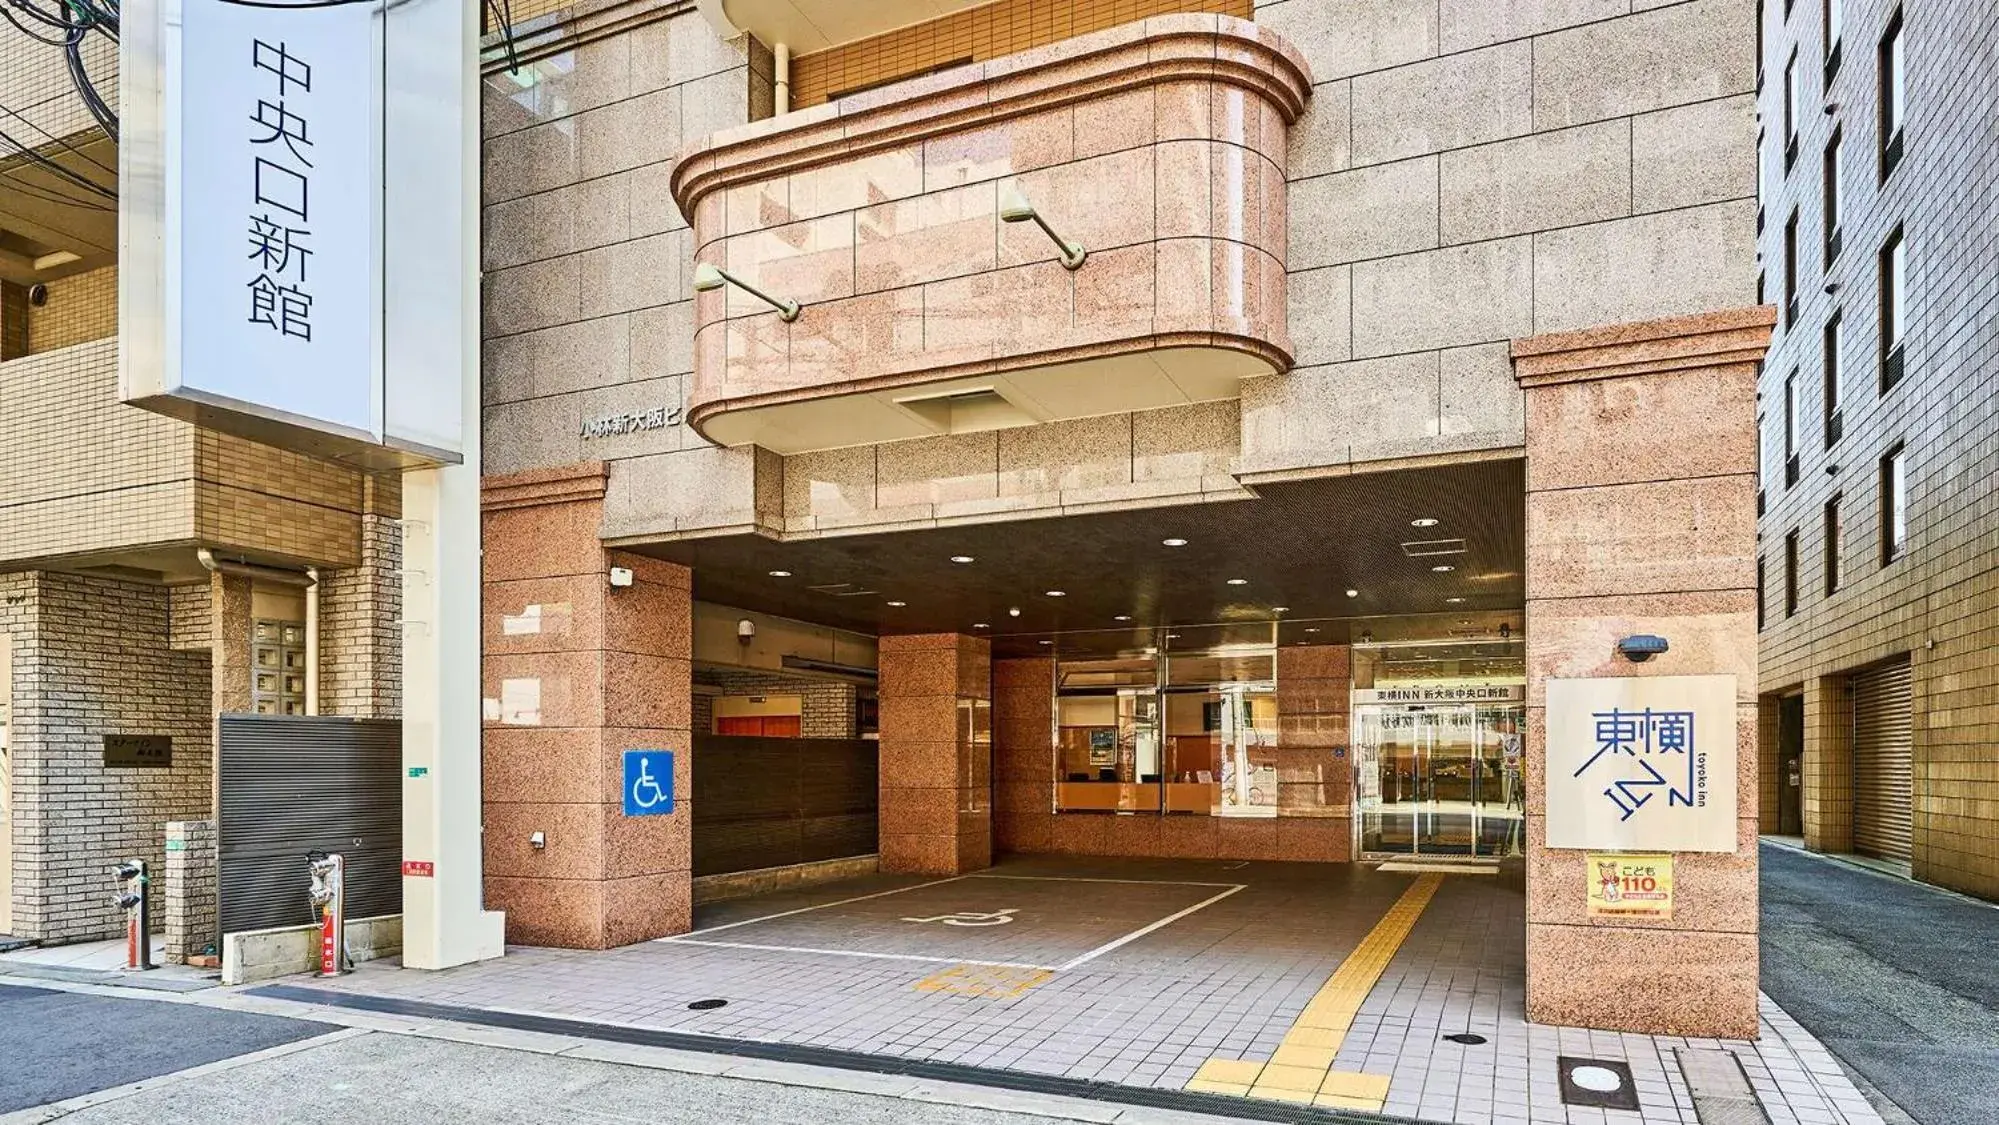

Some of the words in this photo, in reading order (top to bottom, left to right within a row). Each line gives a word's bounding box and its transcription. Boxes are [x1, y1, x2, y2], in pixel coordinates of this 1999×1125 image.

[247, 37, 314, 342] 中央口新館
[580, 406, 687, 440] 小林新大阪ビ
[1377, 690, 1420, 700] 東横INN
[1424, 688, 1509, 699] 新大阪中央口新館
[1696, 752, 1708, 788] toyoko
[1697, 791, 1708, 808] inn
[1622, 865, 1656, 877] こども
[1621, 876, 1656, 892] 110
